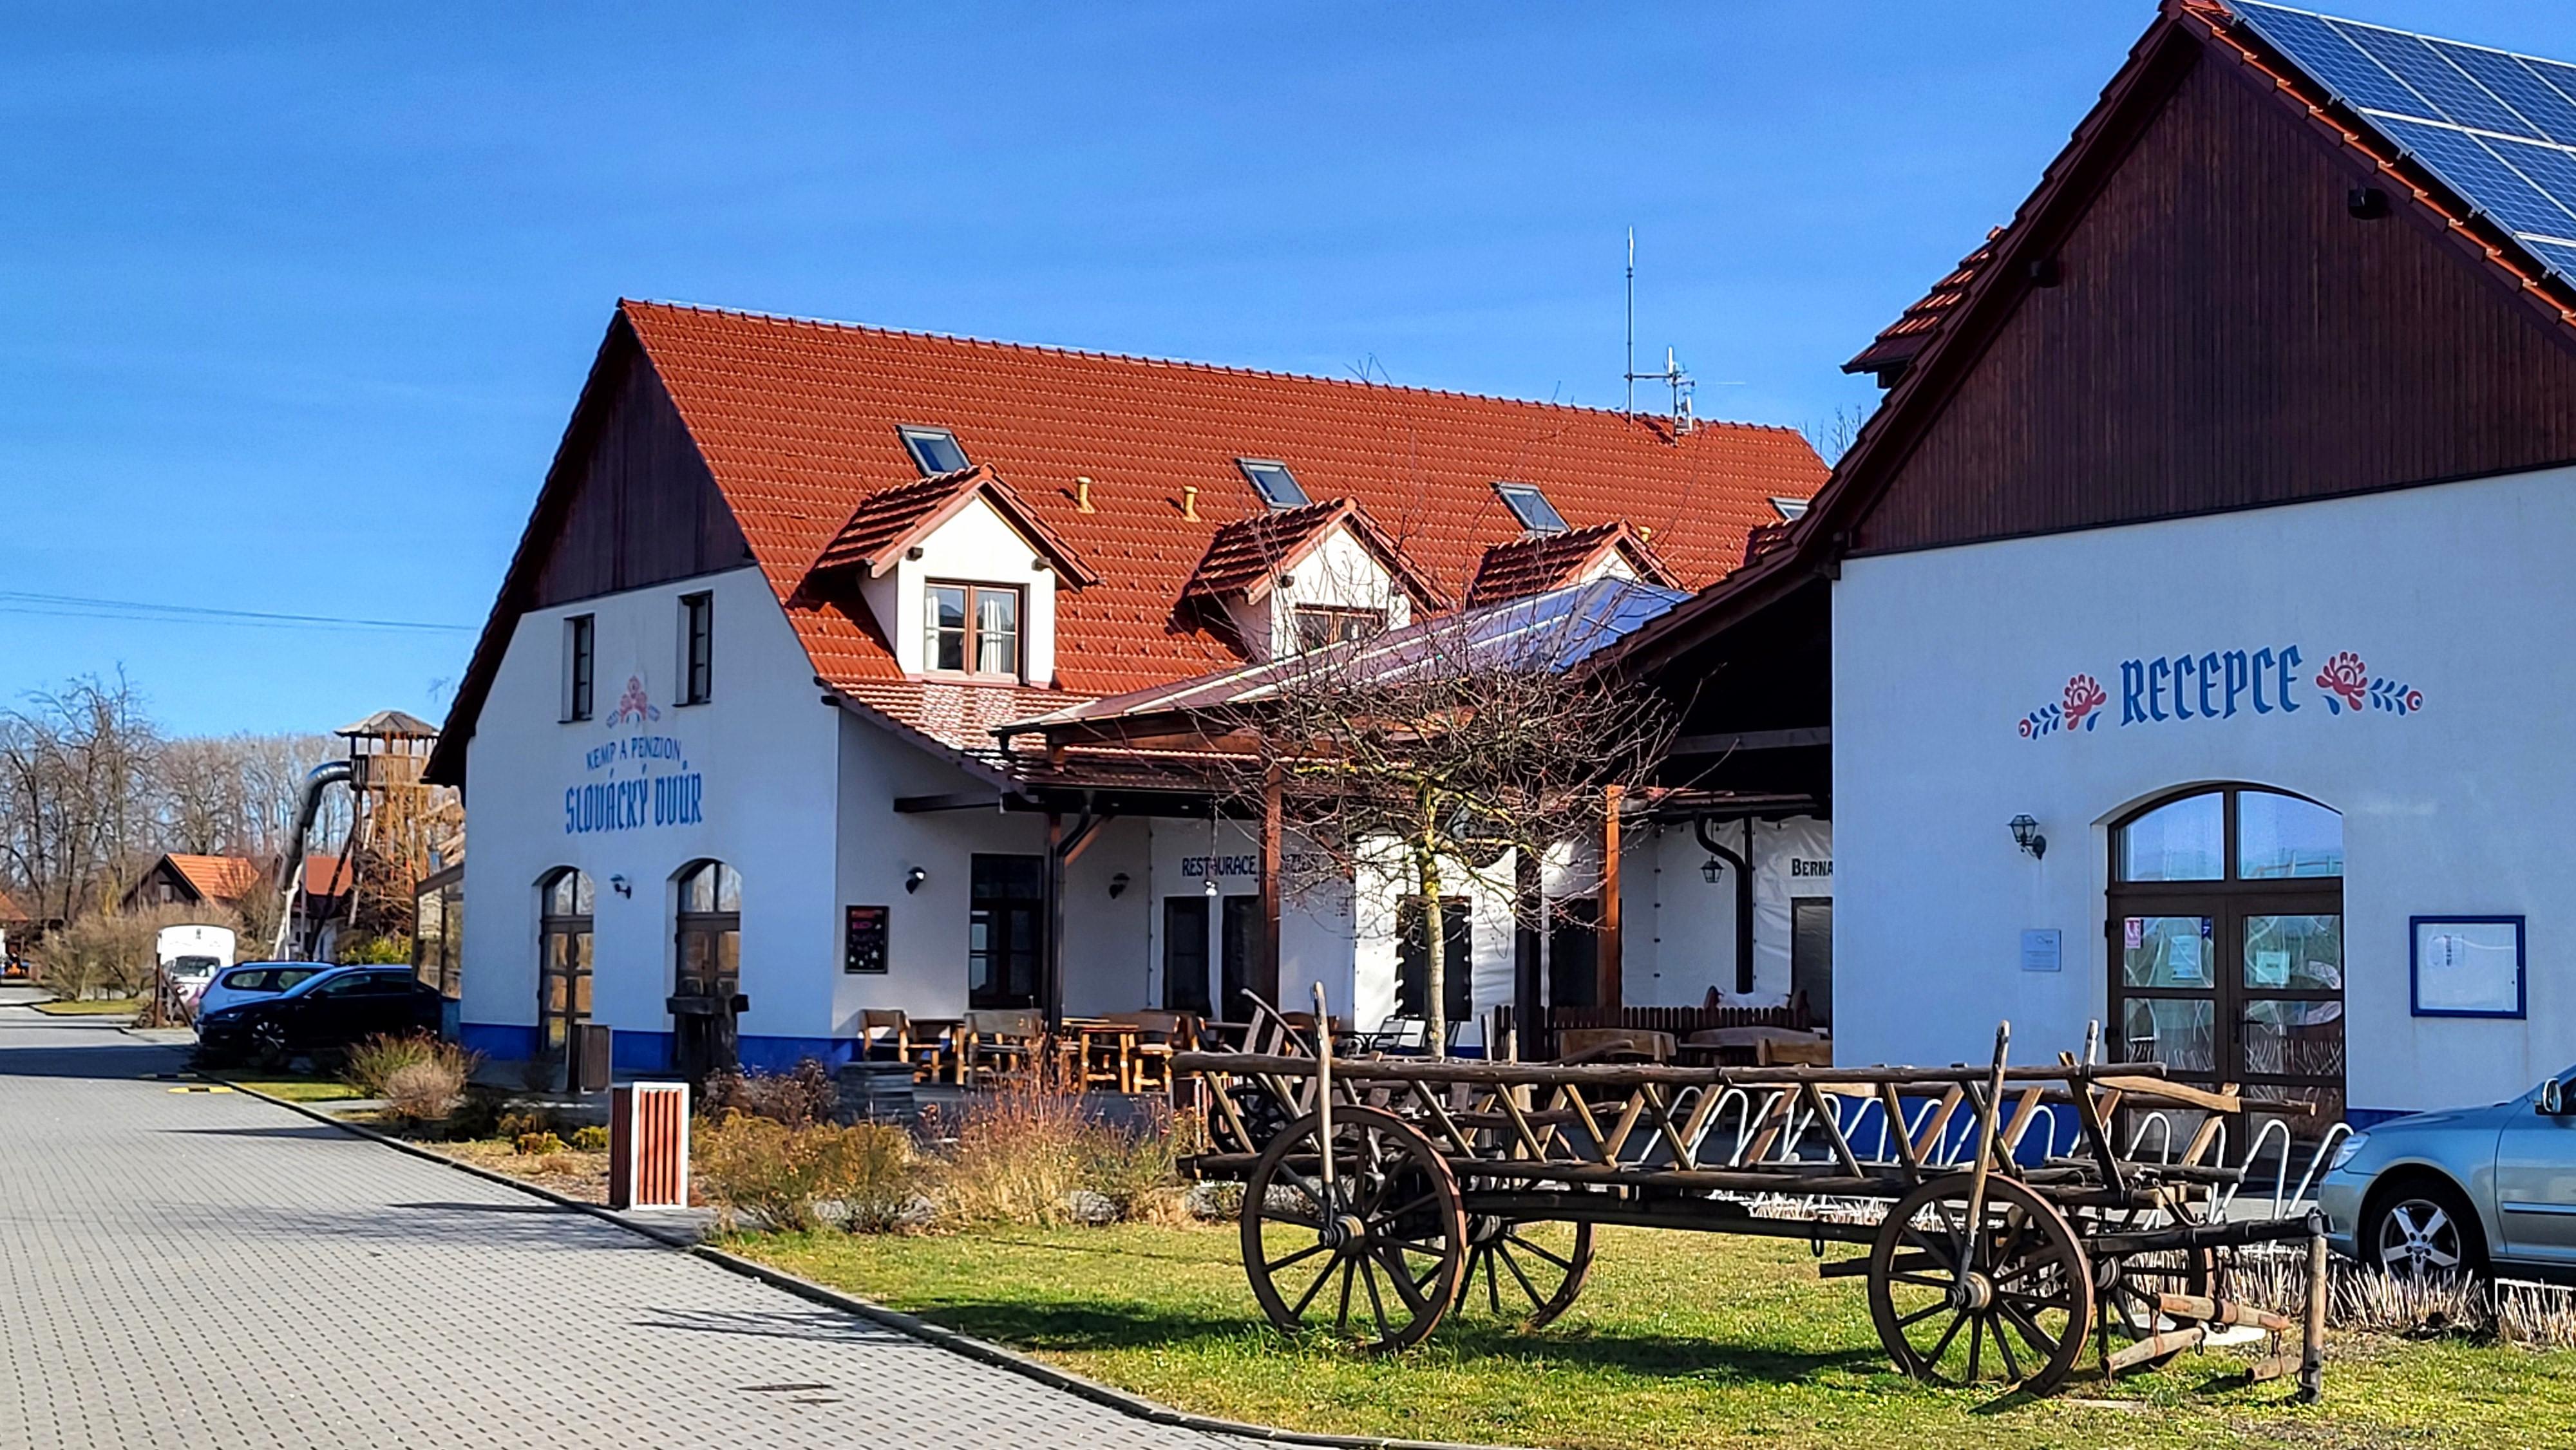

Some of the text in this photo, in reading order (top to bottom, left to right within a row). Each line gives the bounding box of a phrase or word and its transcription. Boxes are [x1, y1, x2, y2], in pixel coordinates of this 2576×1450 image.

[2119, 645, 2303, 727] RECEPCE
[586, 737, 681, 771] KEMP A PENZION
[1182, 855, 1257, 877] RESTAURACE
